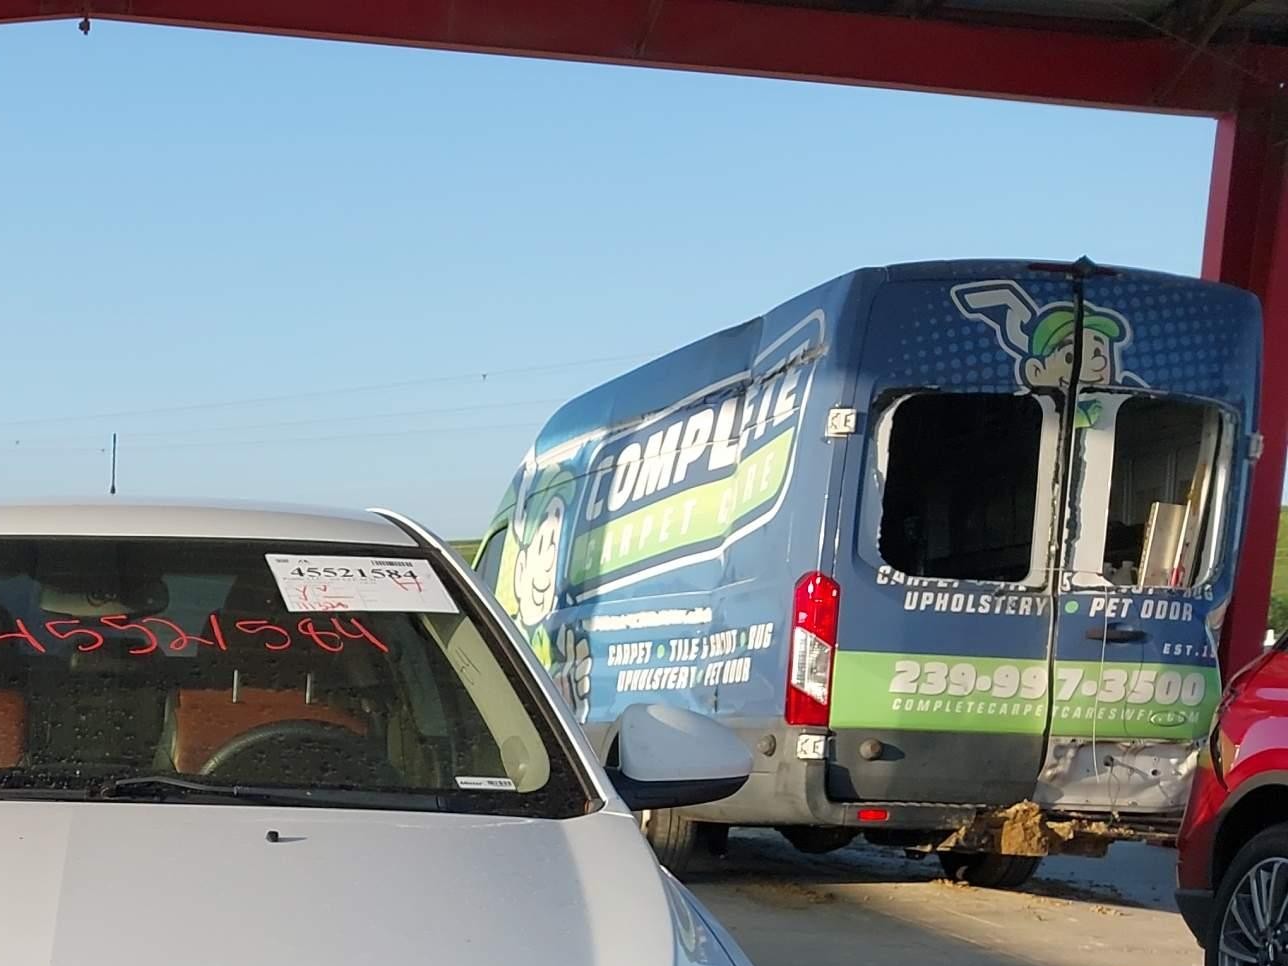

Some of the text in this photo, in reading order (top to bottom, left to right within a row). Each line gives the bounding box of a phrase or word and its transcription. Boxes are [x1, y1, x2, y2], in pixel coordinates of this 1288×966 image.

[586, 352, 801, 521] COMPLETE
[585, 499, 697, 570] CARPET
[290, 566, 419, 580] 45521584
[904, 590, 1193, 622] UPHOLSTERY PET ODOR
[607, 640, 653, 667] CARPET
[668, 637, 700, 662] TILE
[747, 622, 774, 650] RUG
[616, 656, 752, 693] UPHOLSTERY PET ODOR
